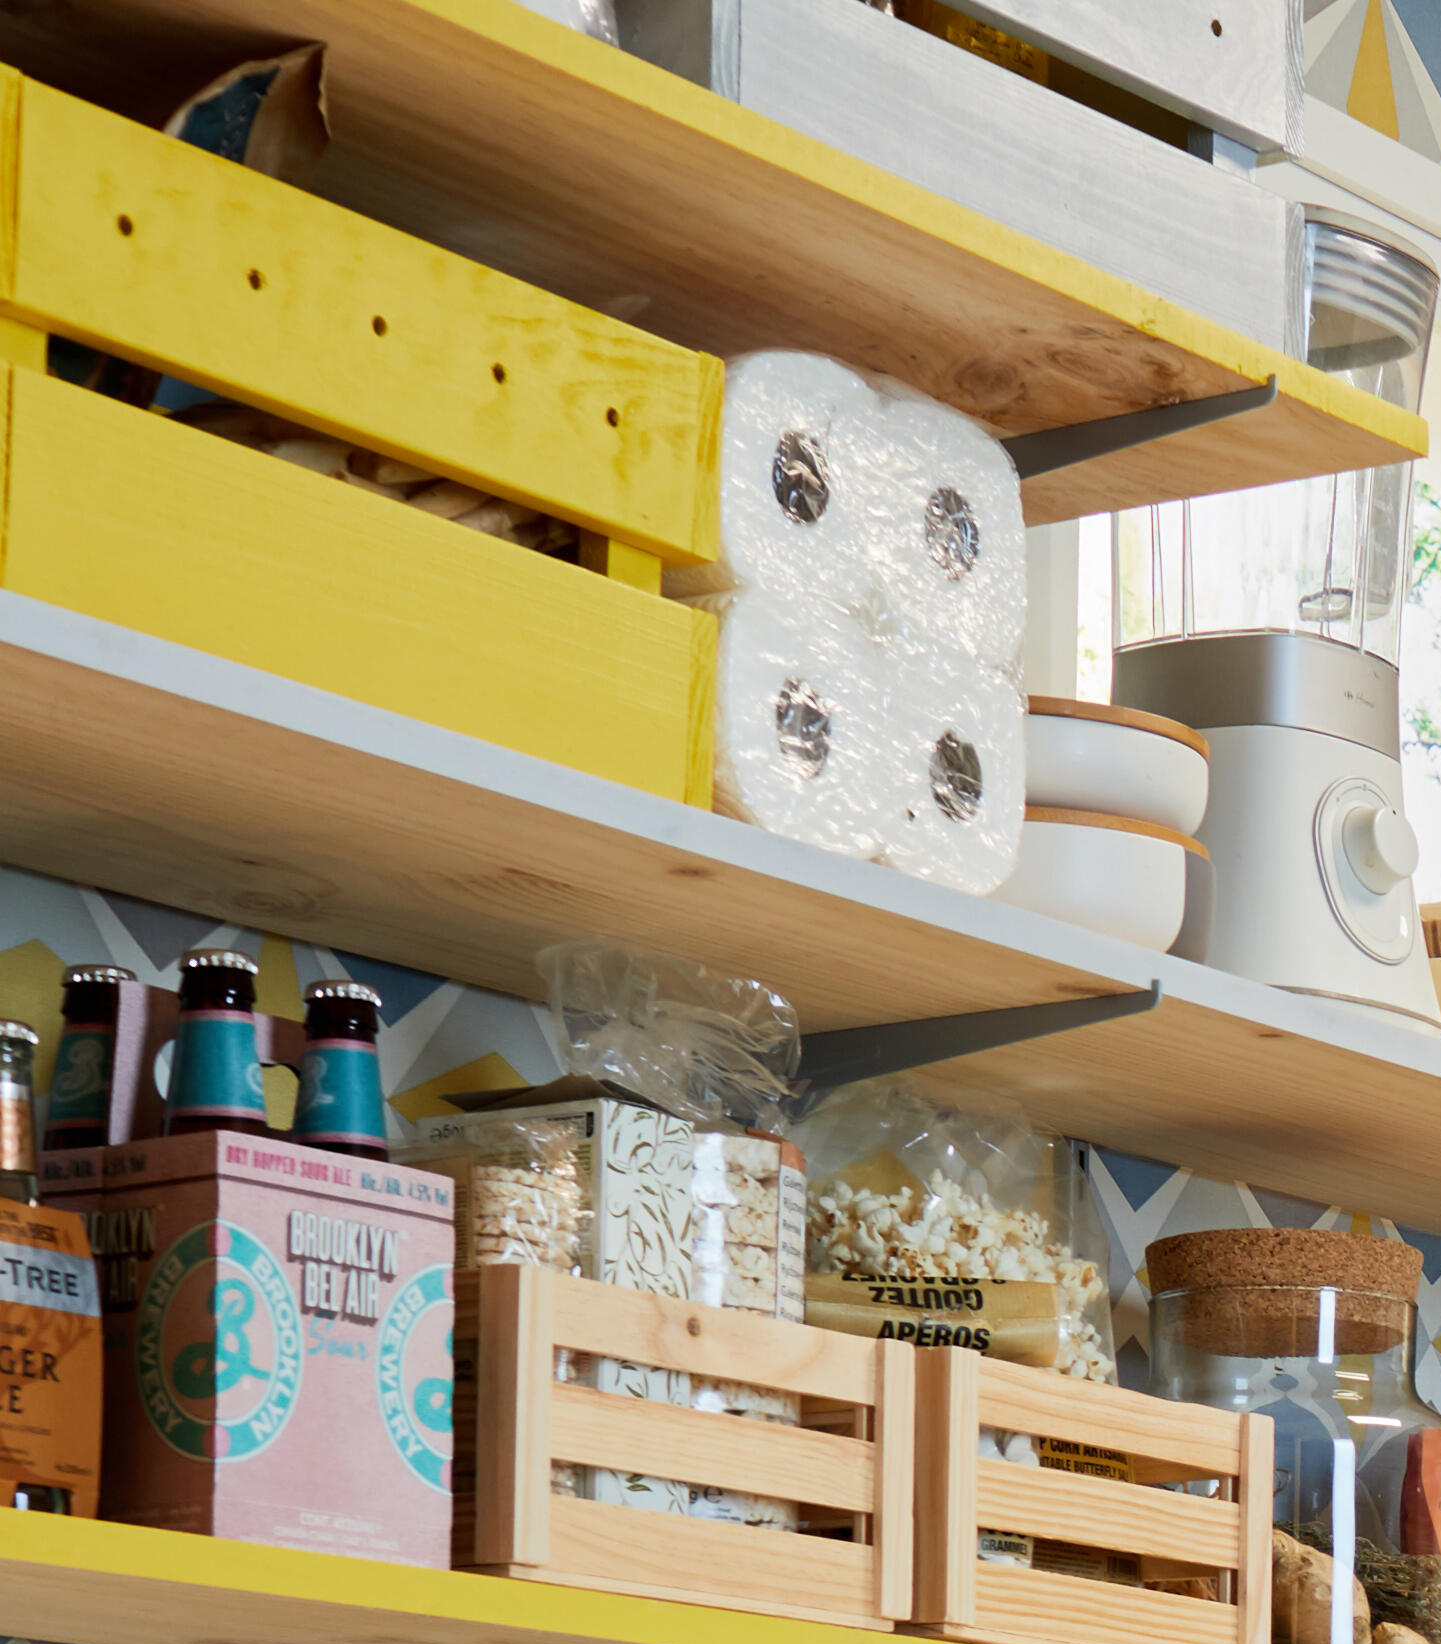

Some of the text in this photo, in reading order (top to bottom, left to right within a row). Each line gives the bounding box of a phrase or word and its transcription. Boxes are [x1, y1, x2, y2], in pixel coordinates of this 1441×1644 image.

[288, 1209, 398, 1279] BROOKLYN
[304, 1261, 380, 1319] BEL AIR
[250, 1253, 298, 1443] BROOKLYN
[379, 1284, 427, 1458] BREWERY
